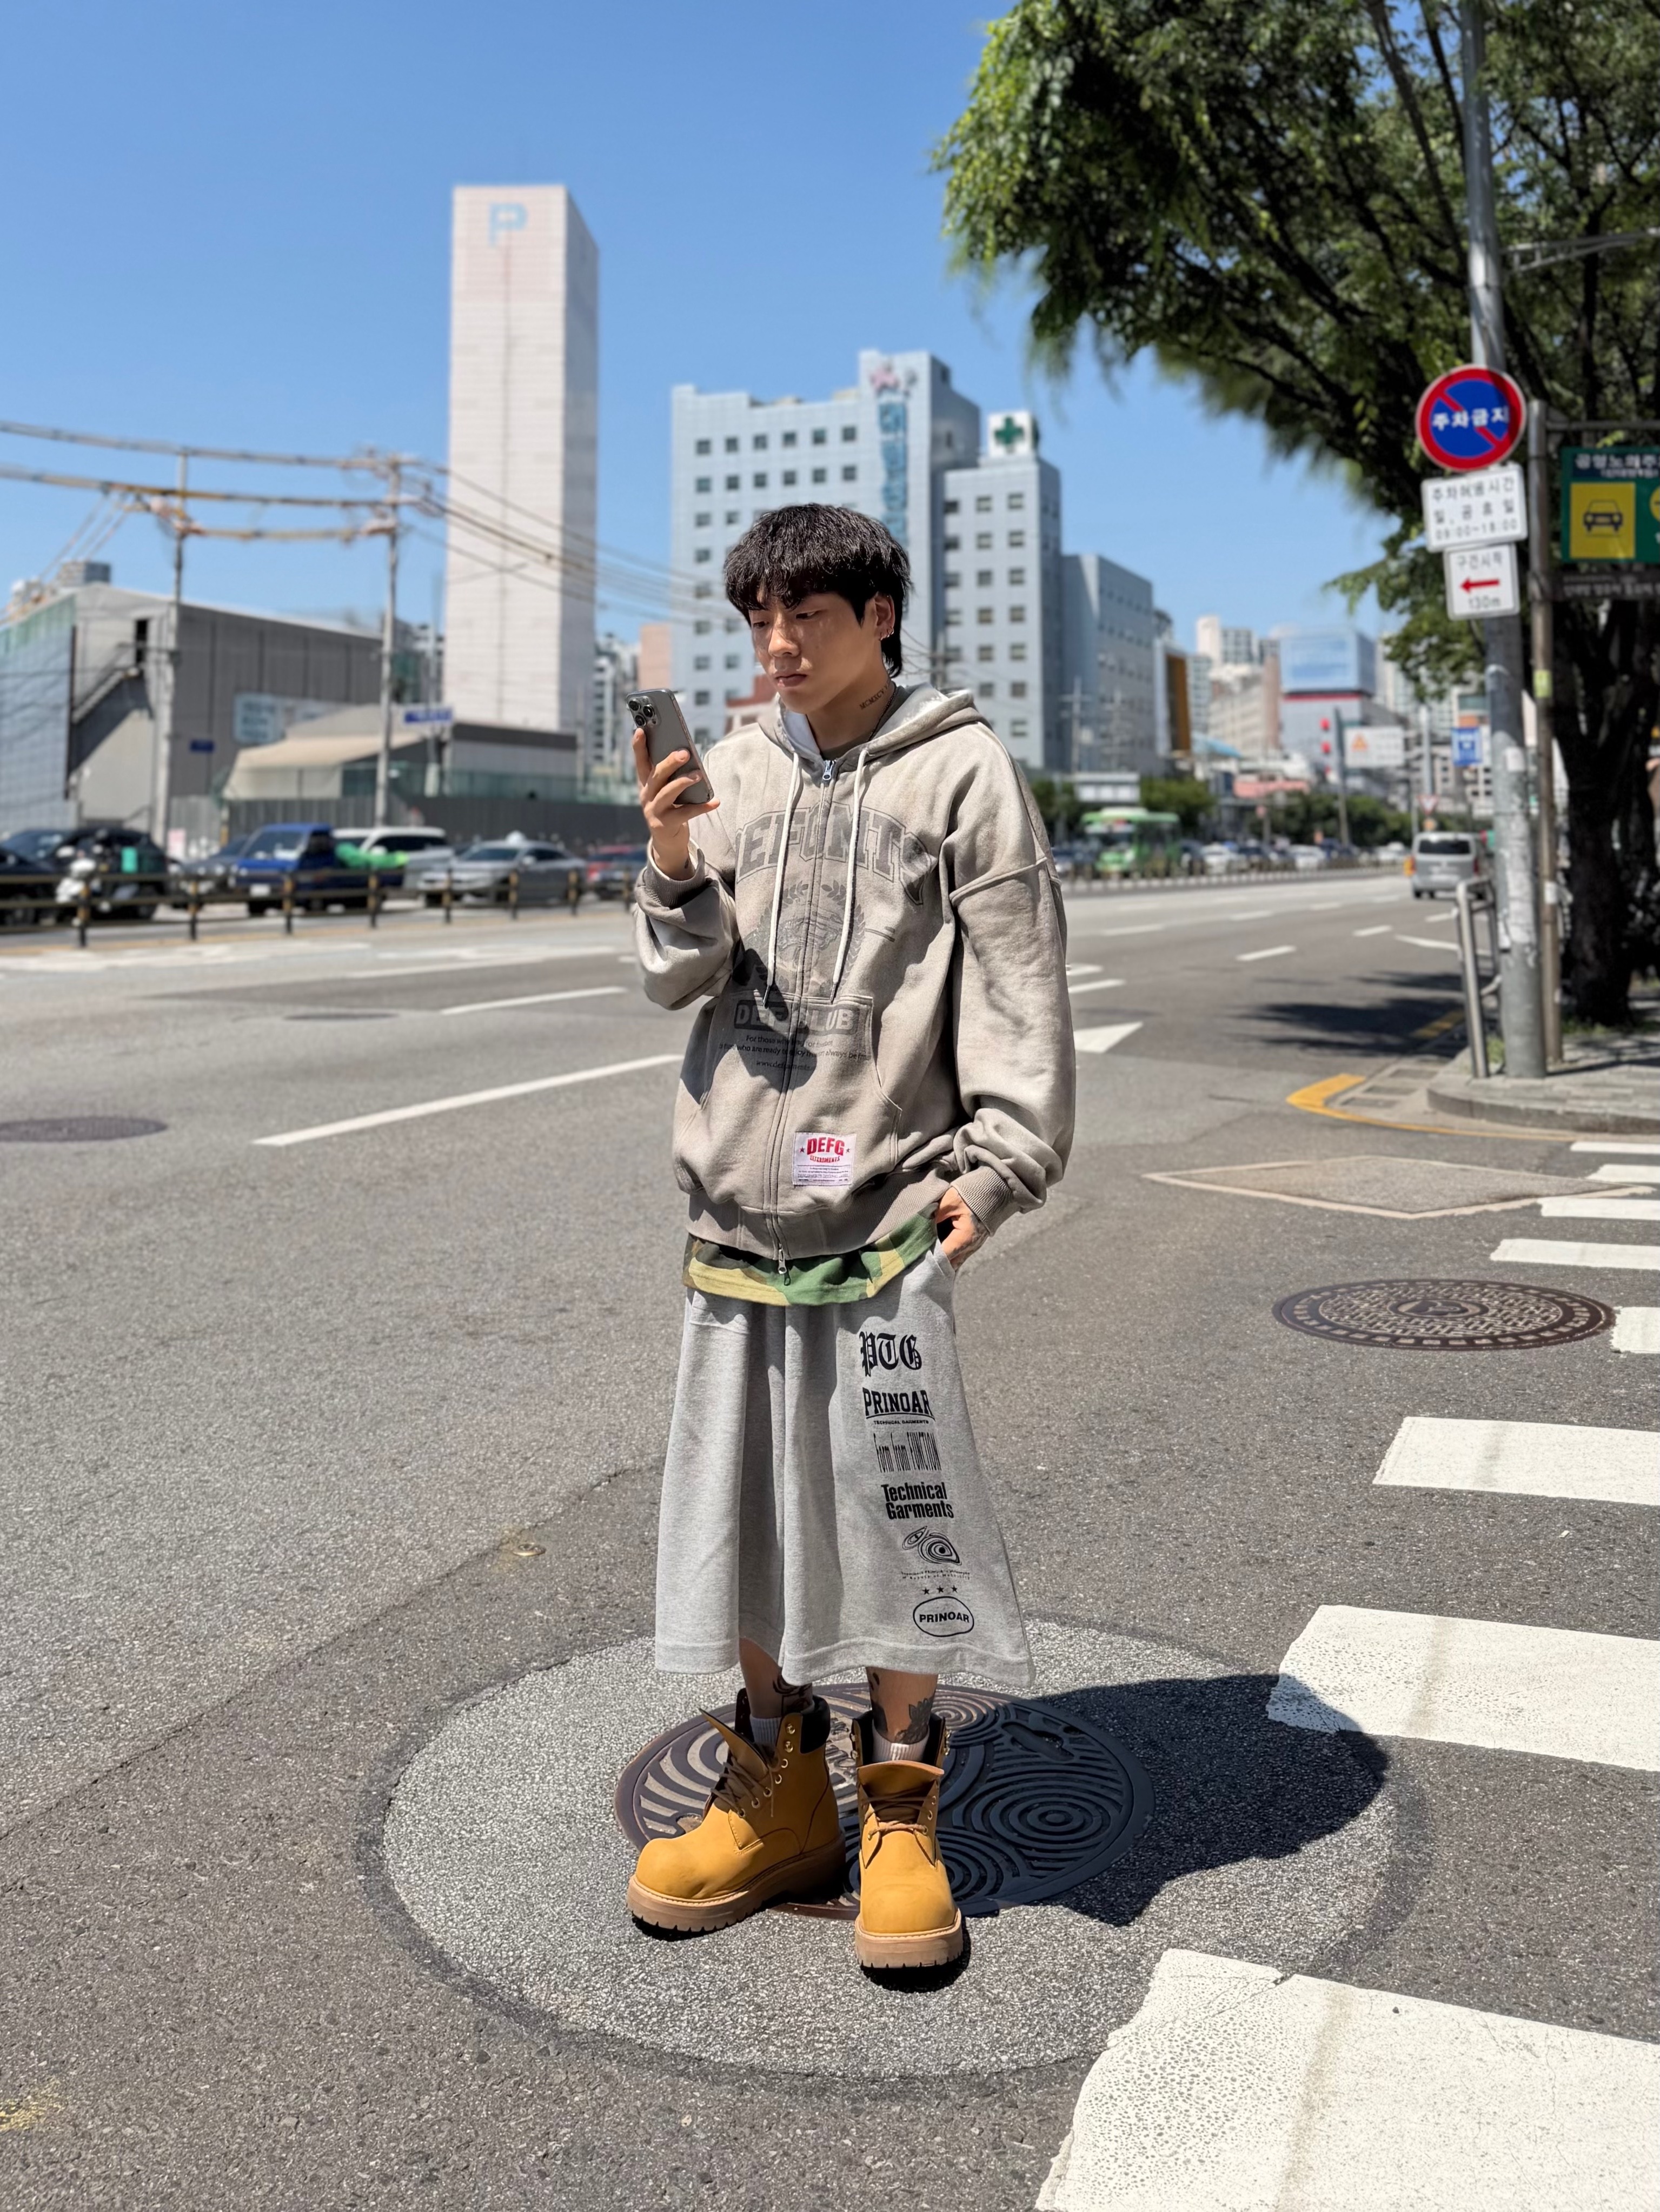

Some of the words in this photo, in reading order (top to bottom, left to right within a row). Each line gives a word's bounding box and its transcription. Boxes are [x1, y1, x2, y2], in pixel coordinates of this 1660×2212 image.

[488, 203, 528, 248] P
[1433, 408, 1509, 431] 주차금지
[1457, 552, 1502, 569] 구간시작
[1469, 596, 1501, 609] 130m
[758, 1036, 776, 1044] those
[826, 1050, 847, 1058] always
[807, 1137, 845, 1156] DEFG
[859, 1331, 922, 1377] PTG
[862, 1387, 935, 1418] PRINOAR
[881, 1482, 947, 1502] Technical
[886, 1500, 954, 1520] Garments
[919, 1611, 970, 1623] PRINOAR
